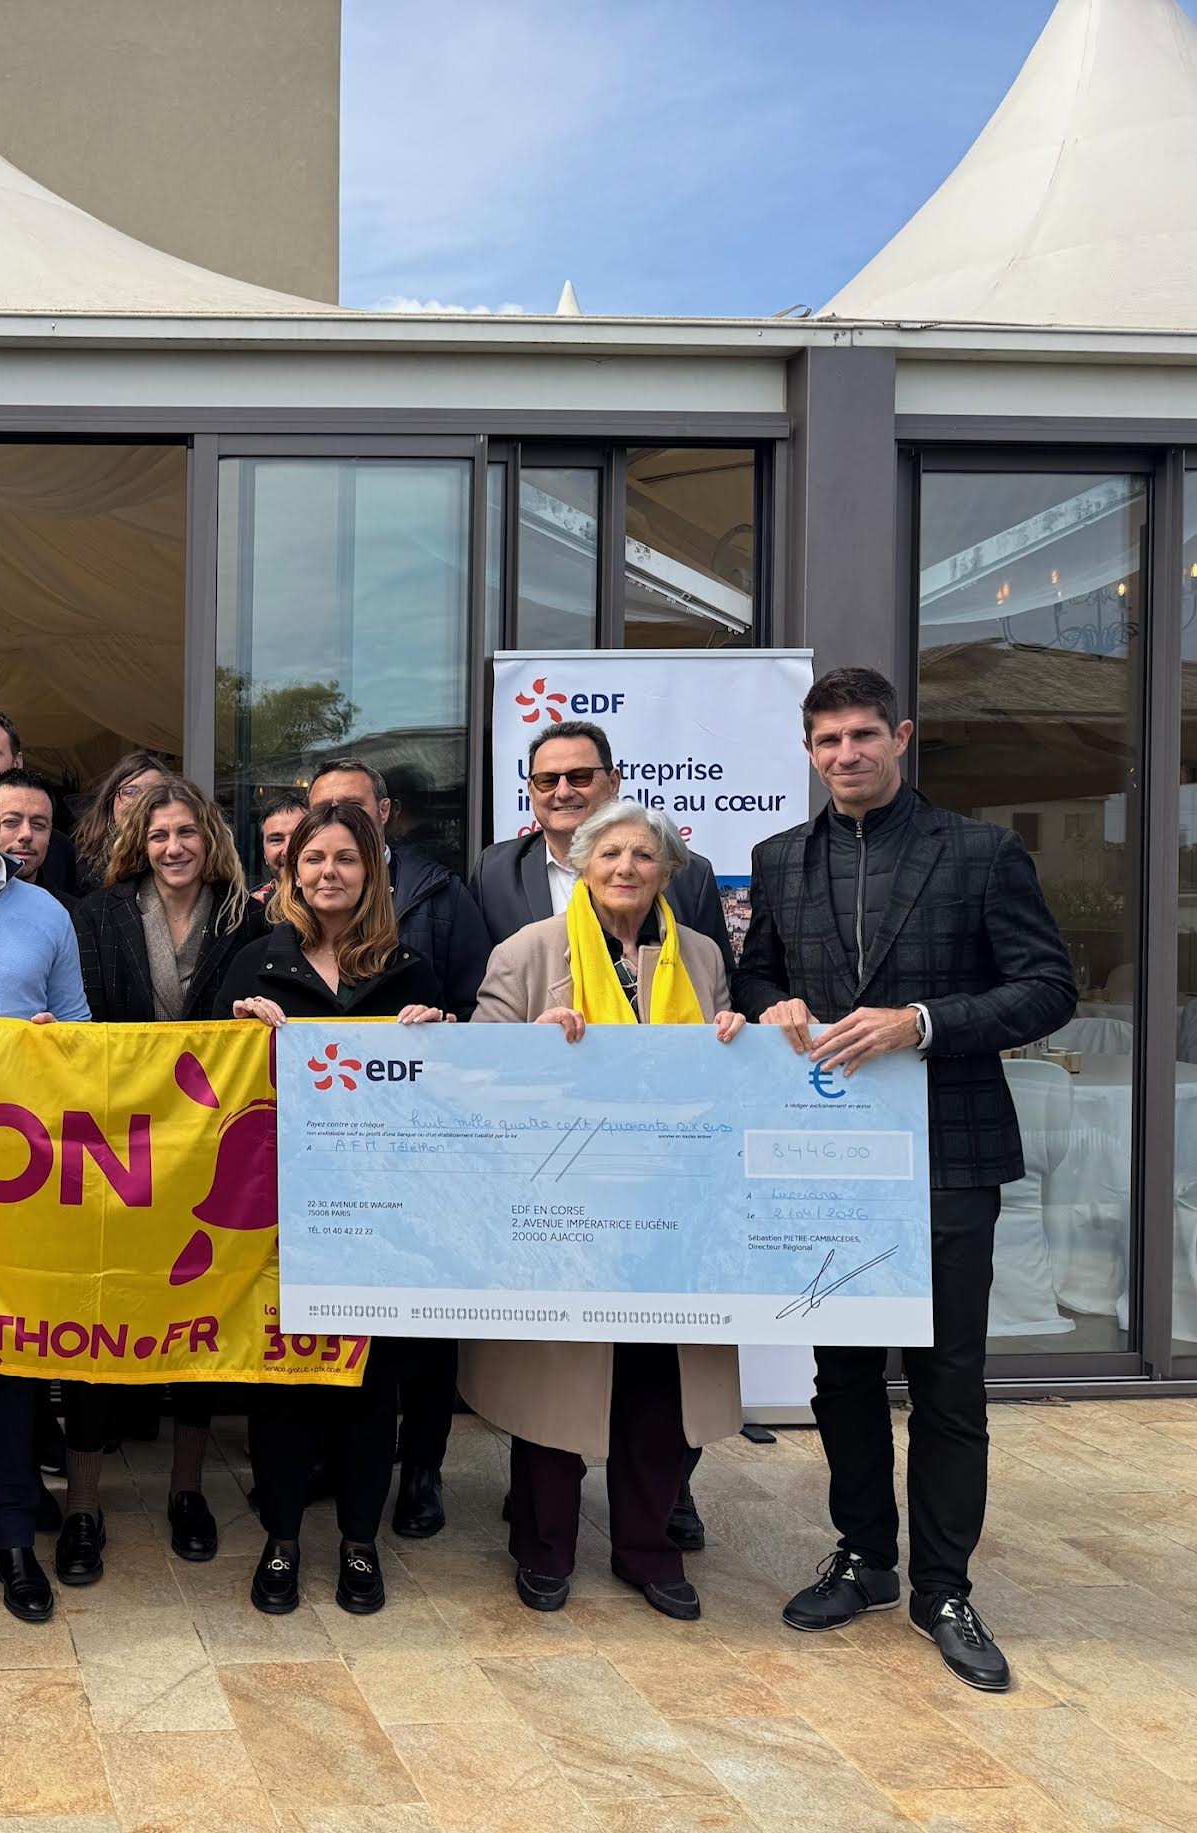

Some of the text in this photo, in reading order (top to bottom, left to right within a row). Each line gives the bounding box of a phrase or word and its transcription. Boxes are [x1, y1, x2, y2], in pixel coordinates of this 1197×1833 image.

[615, 757, 724, 786] treprise
[673, 794, 706, 812] au
[715, 794, 786, 812] cœur
[306, 1120, 325, 1129] Payez
[330, 1201, 358, 1209] AVENUE
[511, 1205, 585, 1215] EDF EN CORSE
[523, 1218, 564, 1229] AVENUE
[566, 1217, 632, 1230] IMPÉRATRICE
[635, 1218, 679, 1230] EUGÉNIE
[323, 1227, 331, 1235] 01
[332, 1227, 342, 1235] 40
[512, 1232, 594, 1243] 20000 AJACCIO
[748, 1234, 782, 1242] Sébastien
[748, 1243, 813, 1252] Directeur Régional
